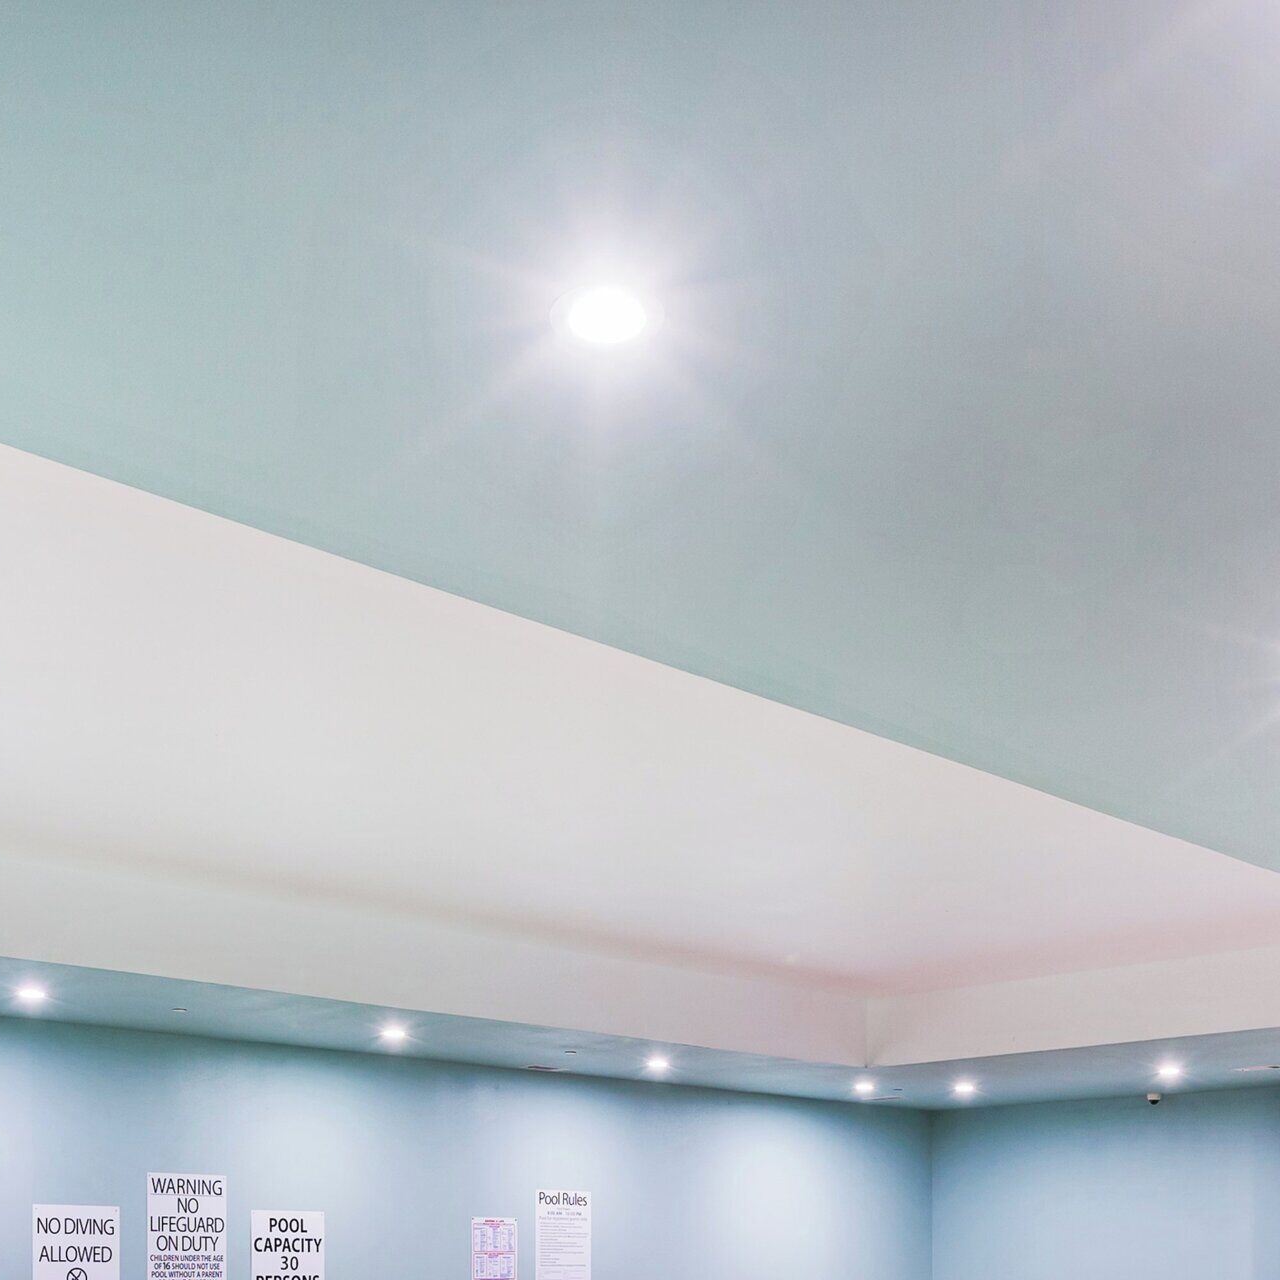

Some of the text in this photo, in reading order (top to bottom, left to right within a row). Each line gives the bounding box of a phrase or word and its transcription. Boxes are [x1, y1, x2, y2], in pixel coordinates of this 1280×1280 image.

[151, 1177, 223, 1196] WARNING
[177, 1197, 199, 1214] NO
[538, 1191, 588, 1206] Pool Rules
[36, 1217, 115, 1236] NO DIVING
[150, 1216, 225, 1233] LIFEGUARD
[269, 1217, 308, 1233] POOL
[156, 1235, 219, 1252] ON DUTY
[253, 1237, 323, 1253] CAPACITY
[38, 1245, 113, 1263] ALLOWED
[150, 1254, 224, 1263] CHILDREN UNDER THE AGE
[154, 1262, 221, 1270] OF 16 SHOULD NOT USE
[280, 1255, 299, 1271] 30
[151, 1270, 167, 1278] POOL
[168, 1270, 195, 1278] WITHOUT
